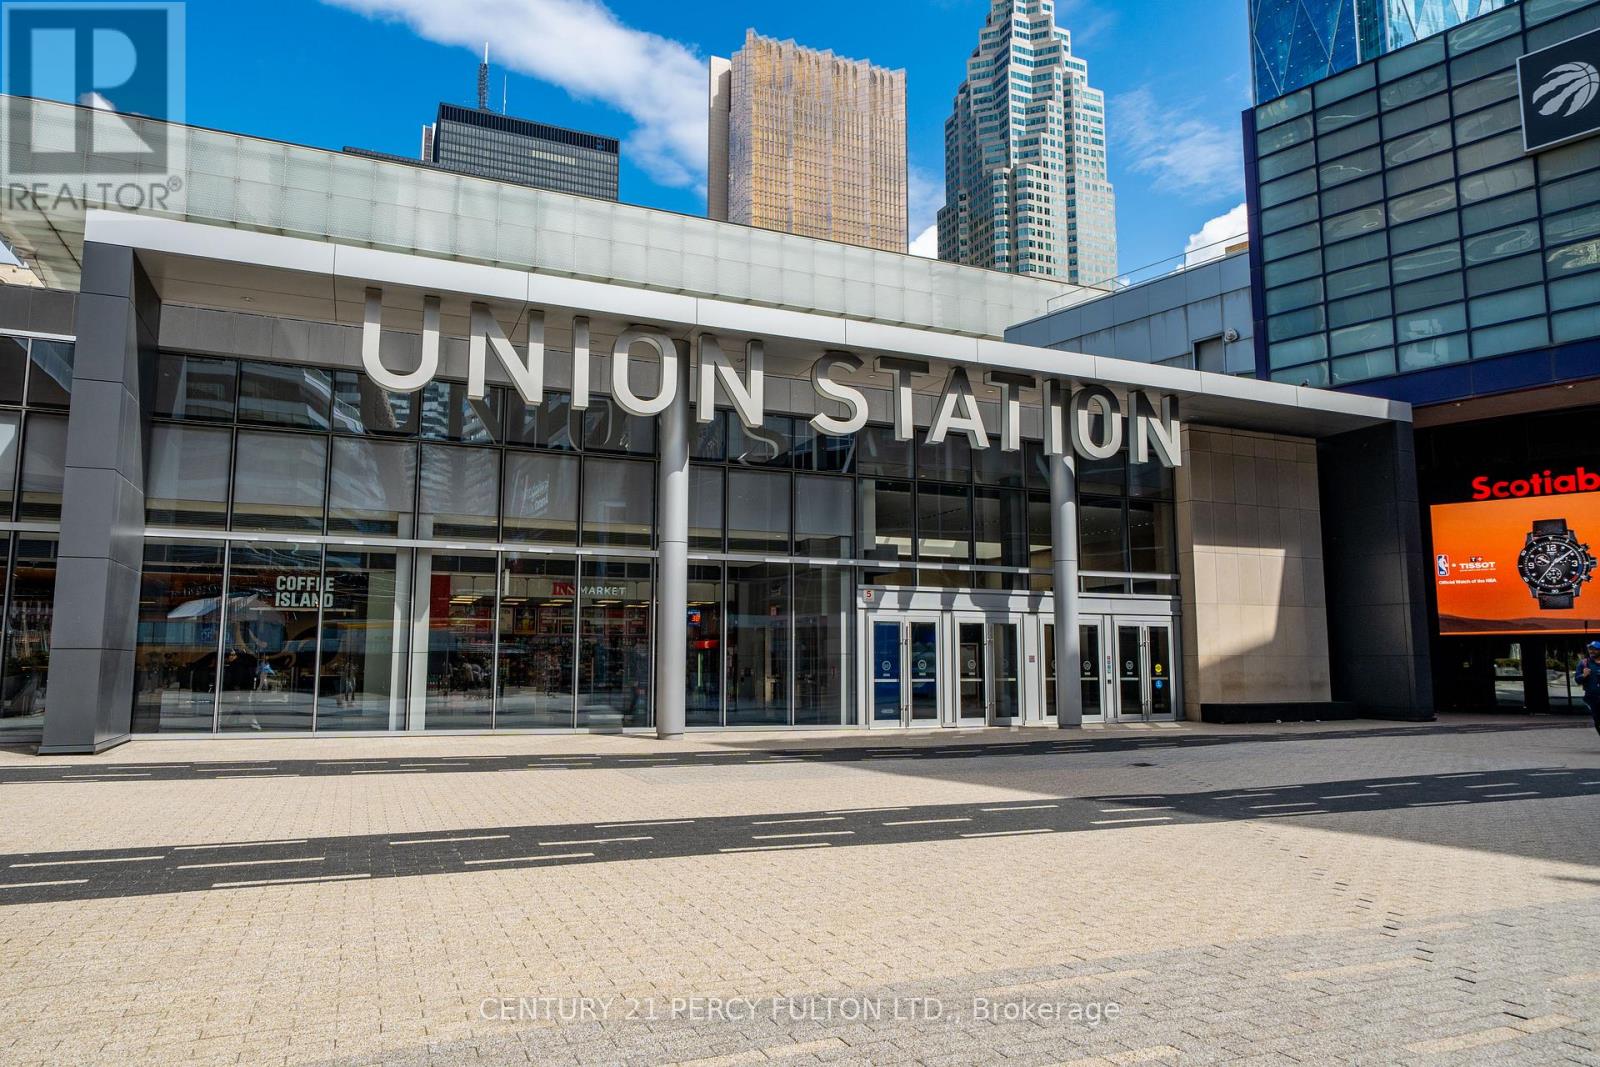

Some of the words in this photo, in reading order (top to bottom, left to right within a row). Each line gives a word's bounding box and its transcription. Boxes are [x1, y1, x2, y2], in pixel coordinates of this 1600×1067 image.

[362, 287, 764, 428] UNION
[809, 350, 1182, 468] STATION
[1459, 561, 1496, 569] TISSOT
[580, 586, 626, 596] MARKET
[866, 590, 872, 598] 5
